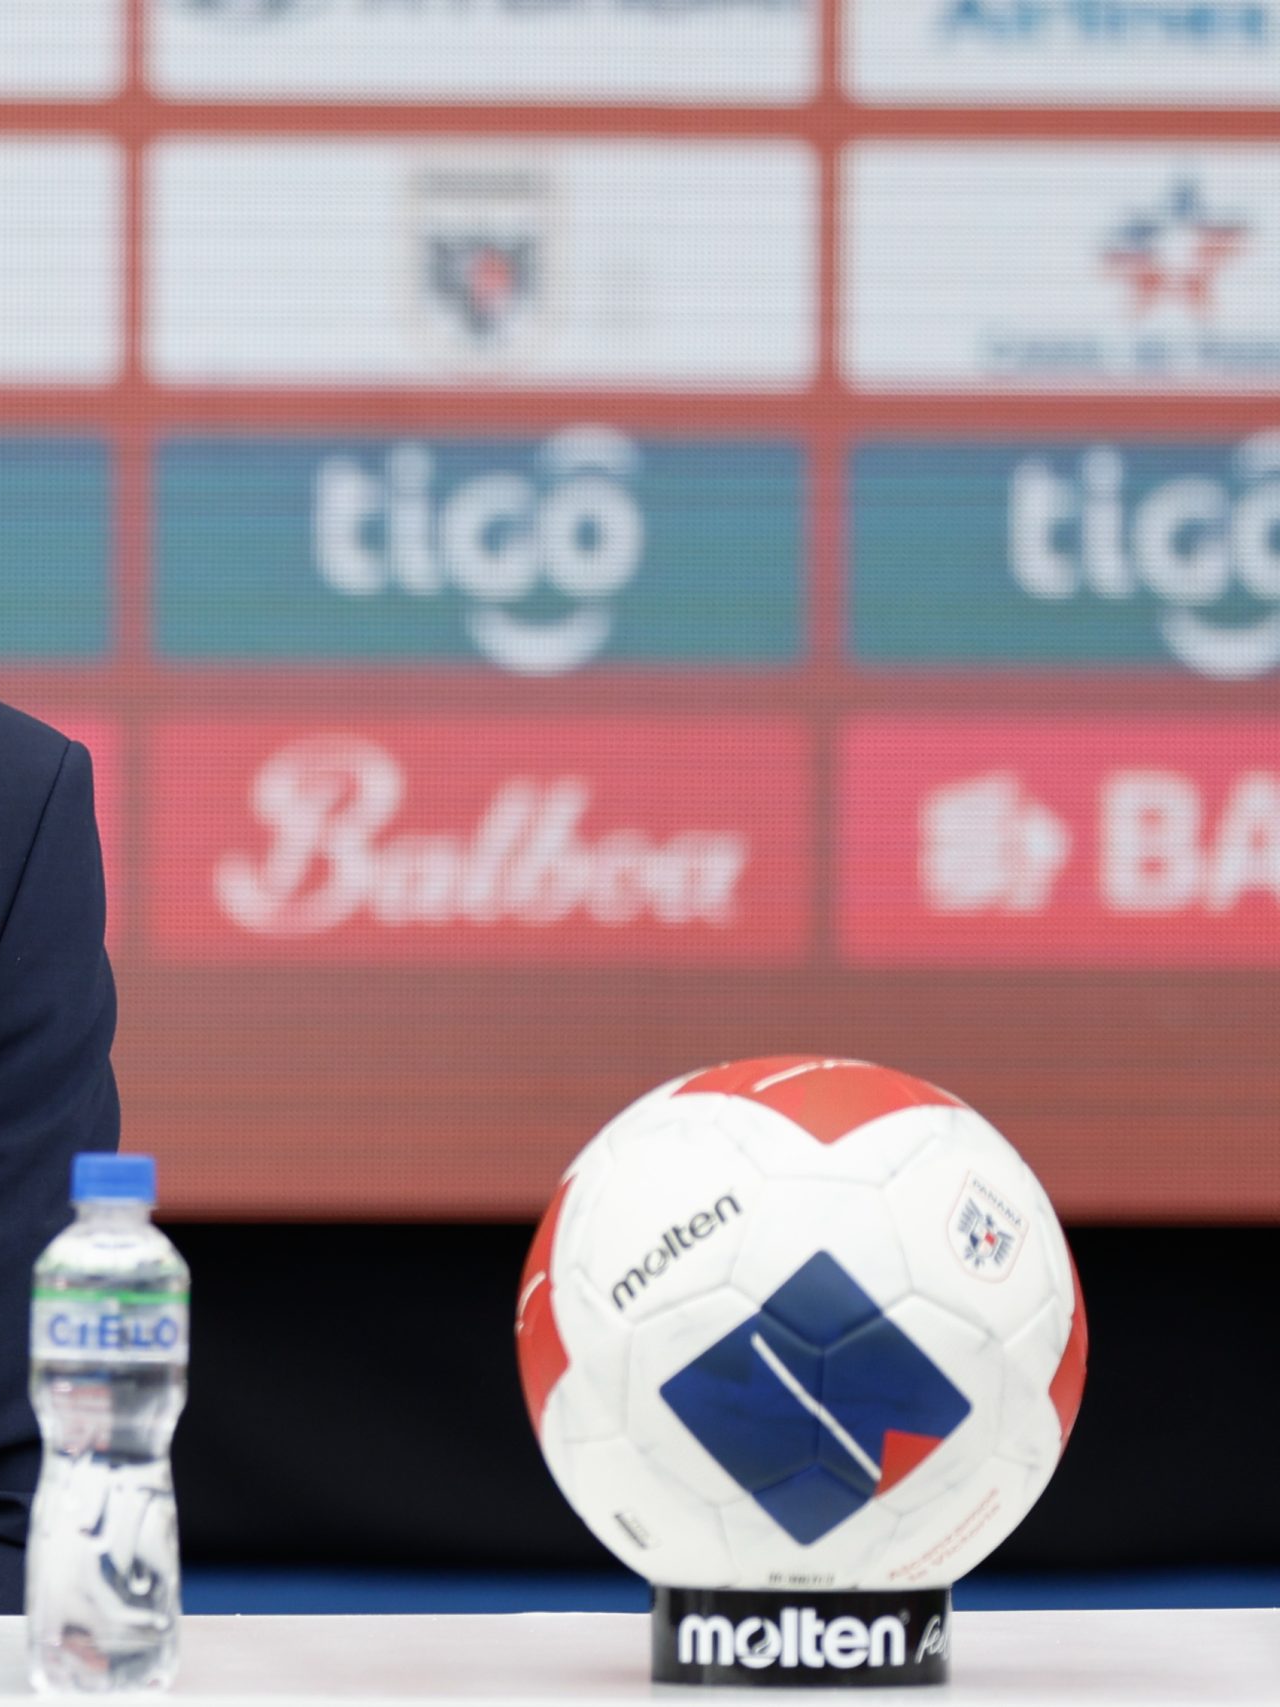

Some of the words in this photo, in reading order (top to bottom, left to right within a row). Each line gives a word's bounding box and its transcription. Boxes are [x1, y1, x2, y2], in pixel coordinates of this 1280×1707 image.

[214, 732, 750, 938] Balboa
[1099, 768, 1280, 914] BA
[612, 1194, 741, 1311] molten
[678, 1607, 906, 1670] molten
